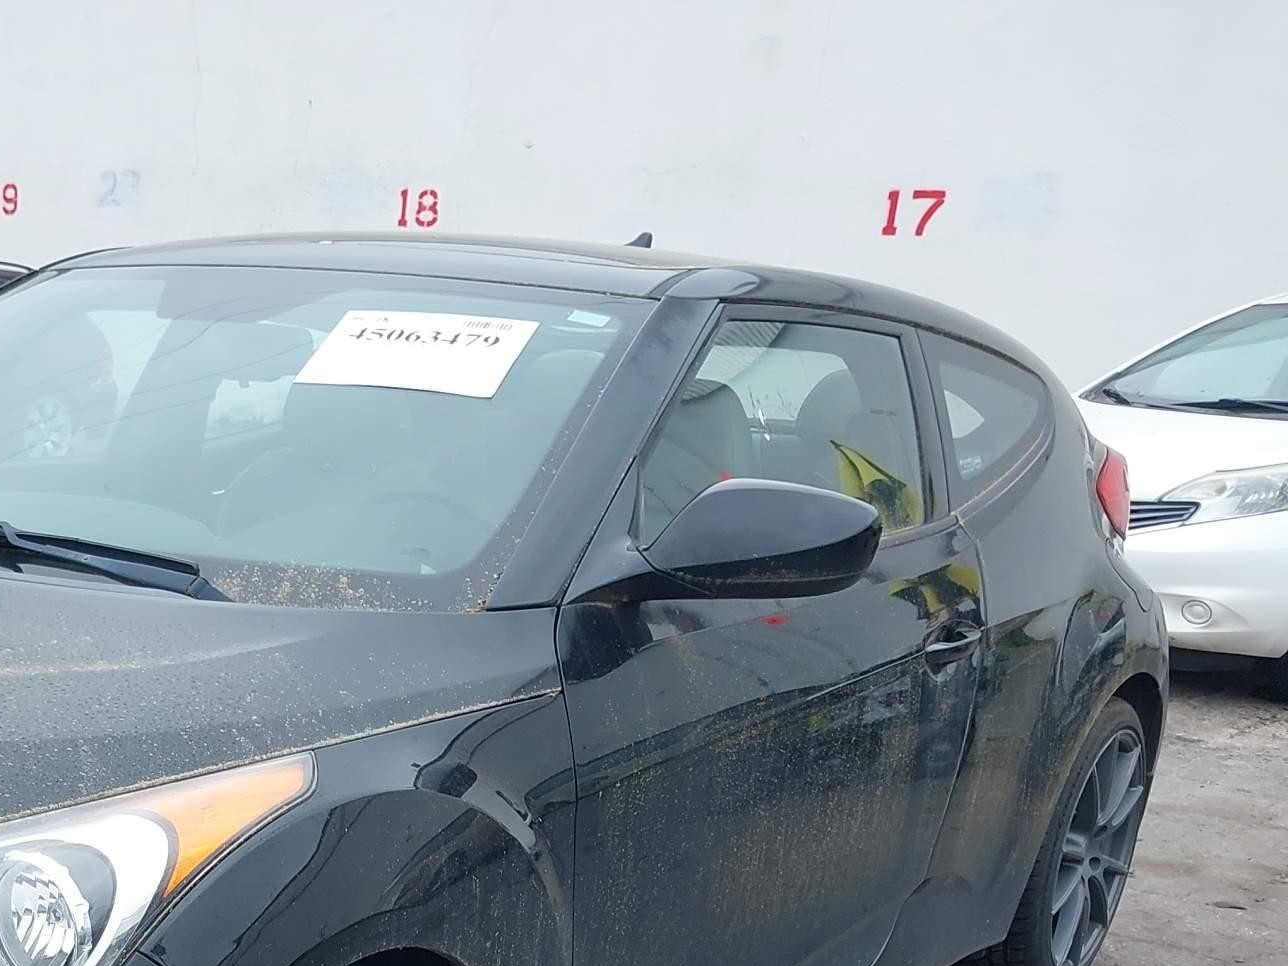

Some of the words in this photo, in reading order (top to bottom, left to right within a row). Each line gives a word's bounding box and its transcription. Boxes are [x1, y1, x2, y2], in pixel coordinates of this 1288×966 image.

[397, 188, 439, 228] 18
[882, 189, 947, 237] 17
[349, 327, 501, 348] 45063479
